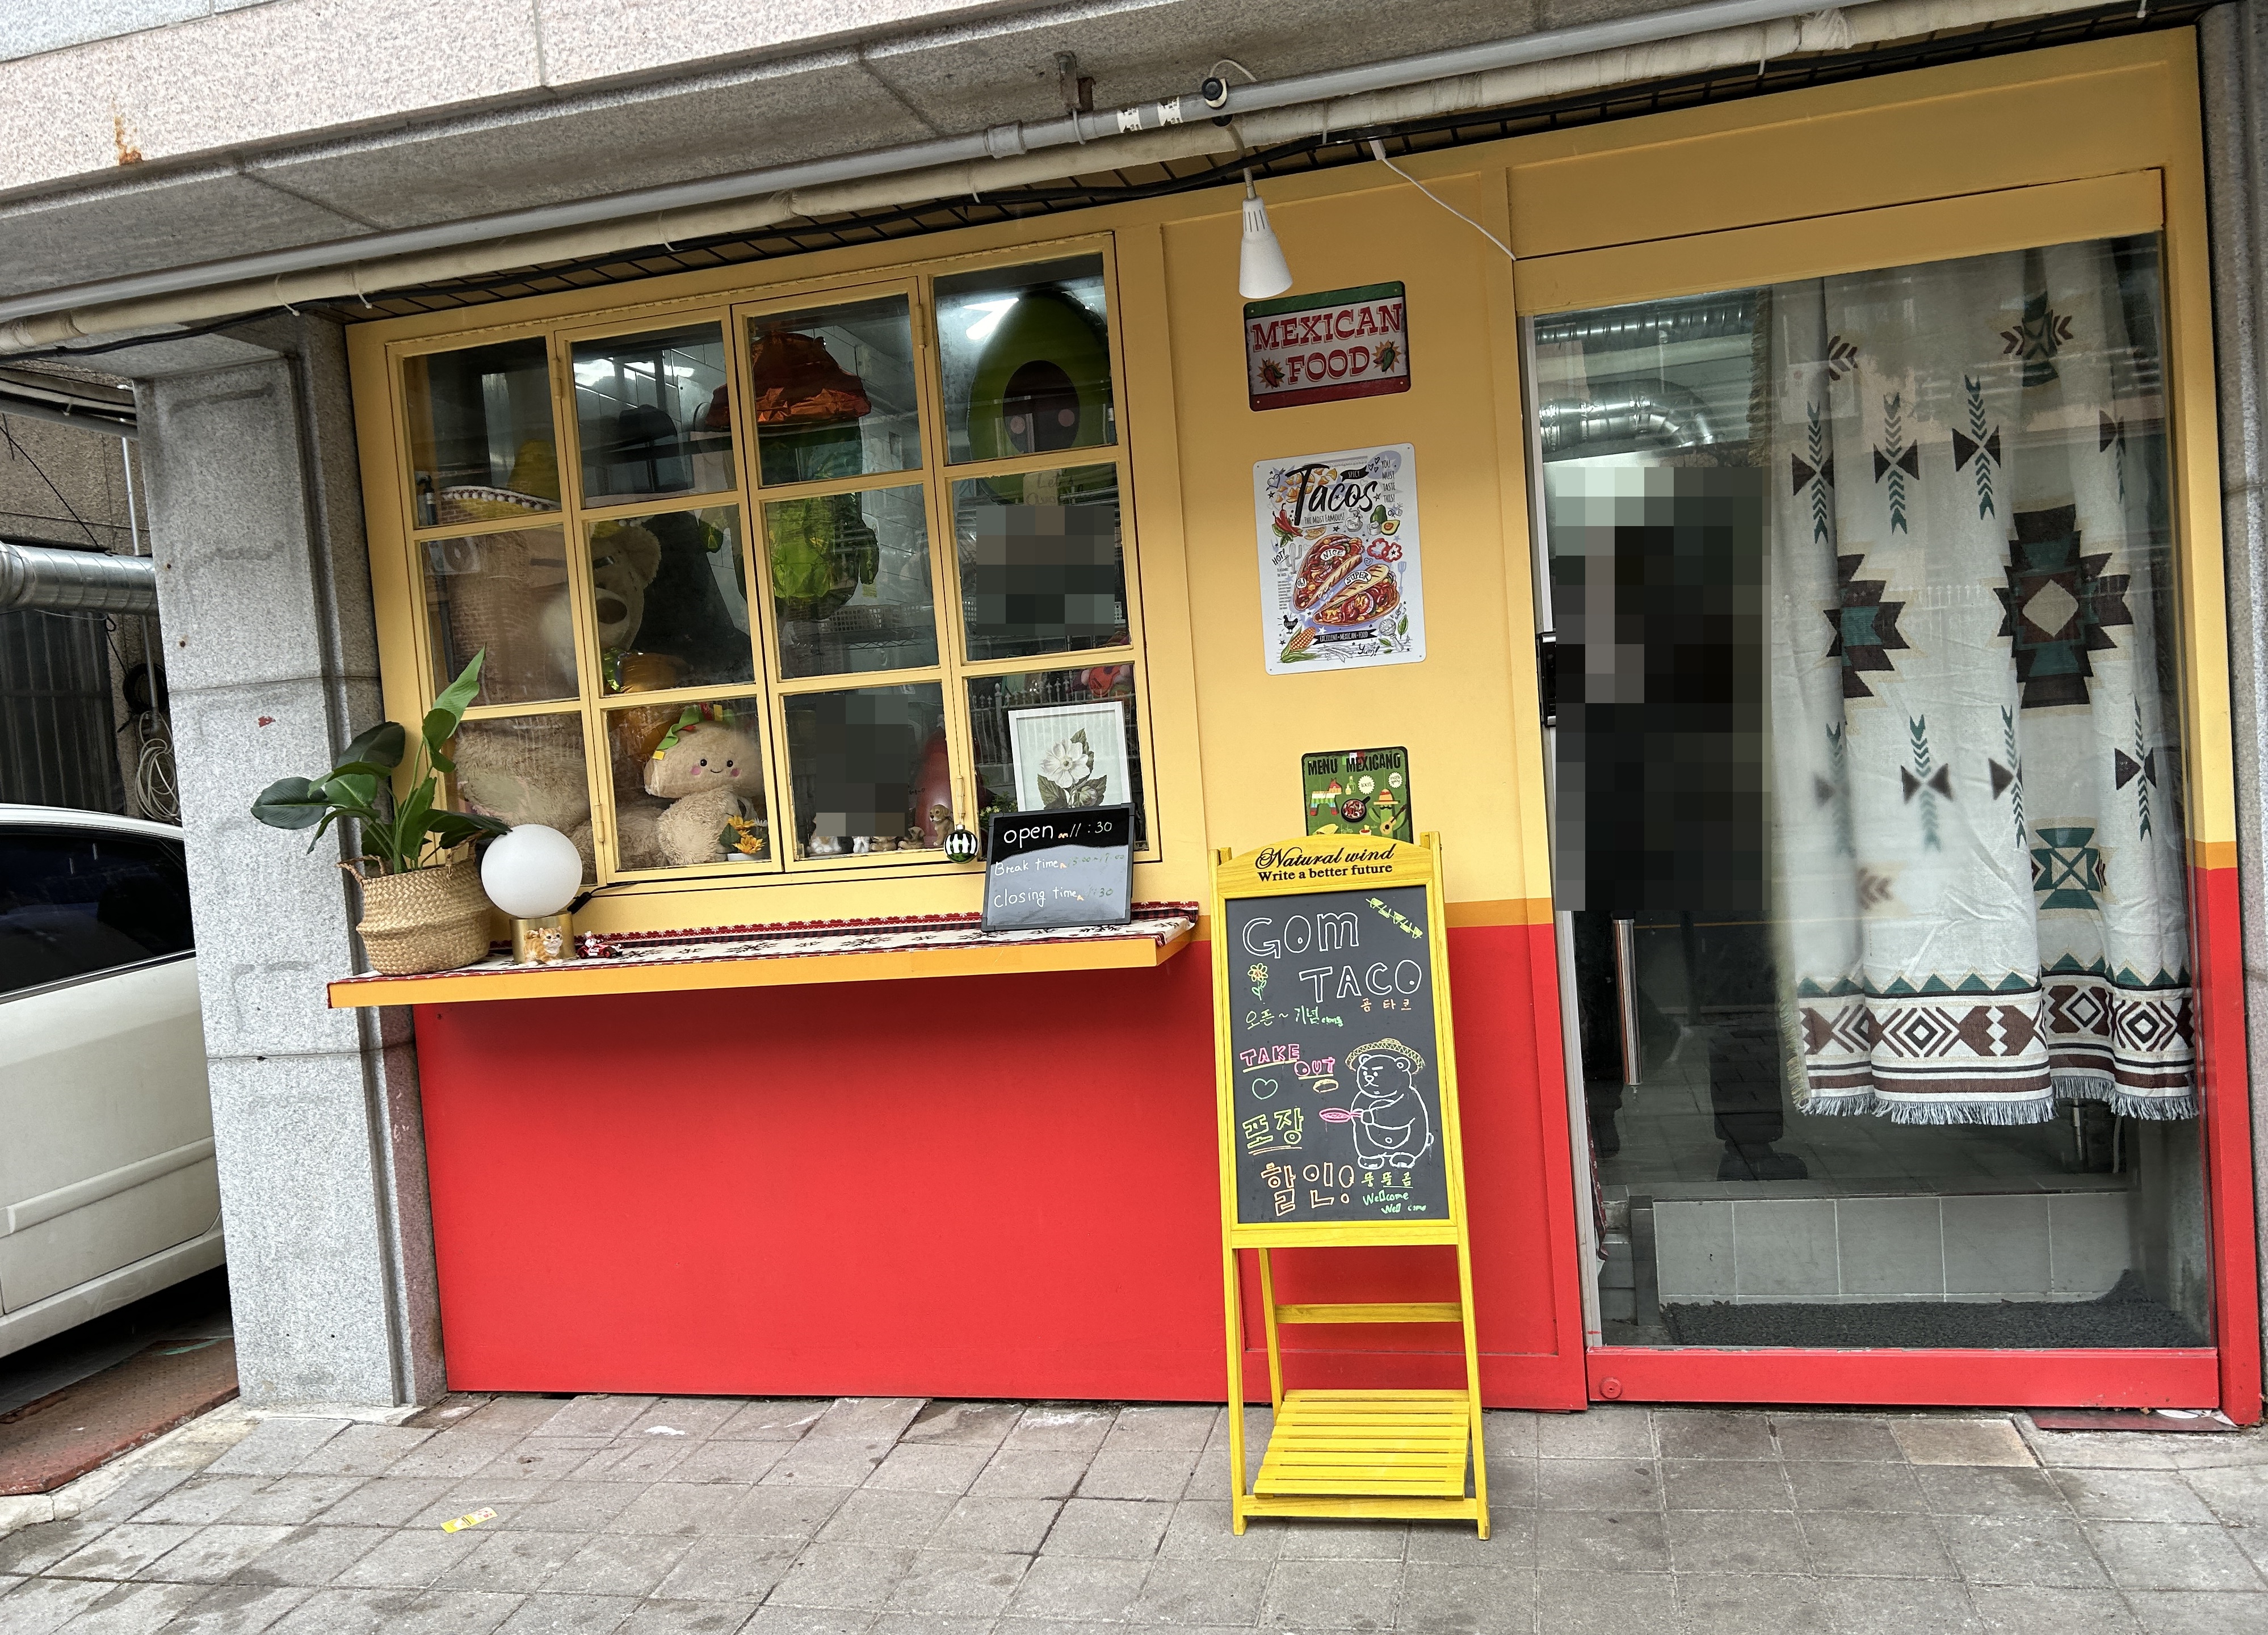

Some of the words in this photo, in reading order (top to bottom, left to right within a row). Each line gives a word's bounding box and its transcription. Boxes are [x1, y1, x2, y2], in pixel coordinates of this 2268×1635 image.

[1251, 303, 1402, 352] MEXICAN
[1286, 346, 1370, 384] FOOD
[1382, 471, 1395, 480] MUST
[1286, 463, 1377, 526] Tacos
[1383, 482, 1396, 491] TASTE
[1312, 515, 1324, 523] MOST
[1272, 548, 1286, 565] HOT!
[1322, 549, 1343, 559] NICE
[1347, 571, 1369, 585] SUPER
[1357, 642, 1380, 657] Yum!
[1308, 758, 1338, 776] MENU
[1346, 752, 1401, 773] MEXICANO
[1003, 825, 1053, 848] open
[1255, 846, 1345, 869] Natural
[1345, 843, 1397, 863] wind
[994, 859, 1029, 876] Break
[1035, 858, 1059, 871] time
[1257, 871, 1295, 882] Write
[1299, 871, 1307, 879] a
[1308, 866, 1349, 878] better
[1351, 864, 1393, 876] future
[1052, 886, 1078, 900] time
[1299, 959, 1422, 1003] TACO
[1240, 1043, 1300, 1066] TAKE
[1294, 1056, 1335, 1077] OUT
[1242, 1107, 1304, 1149] 포장
